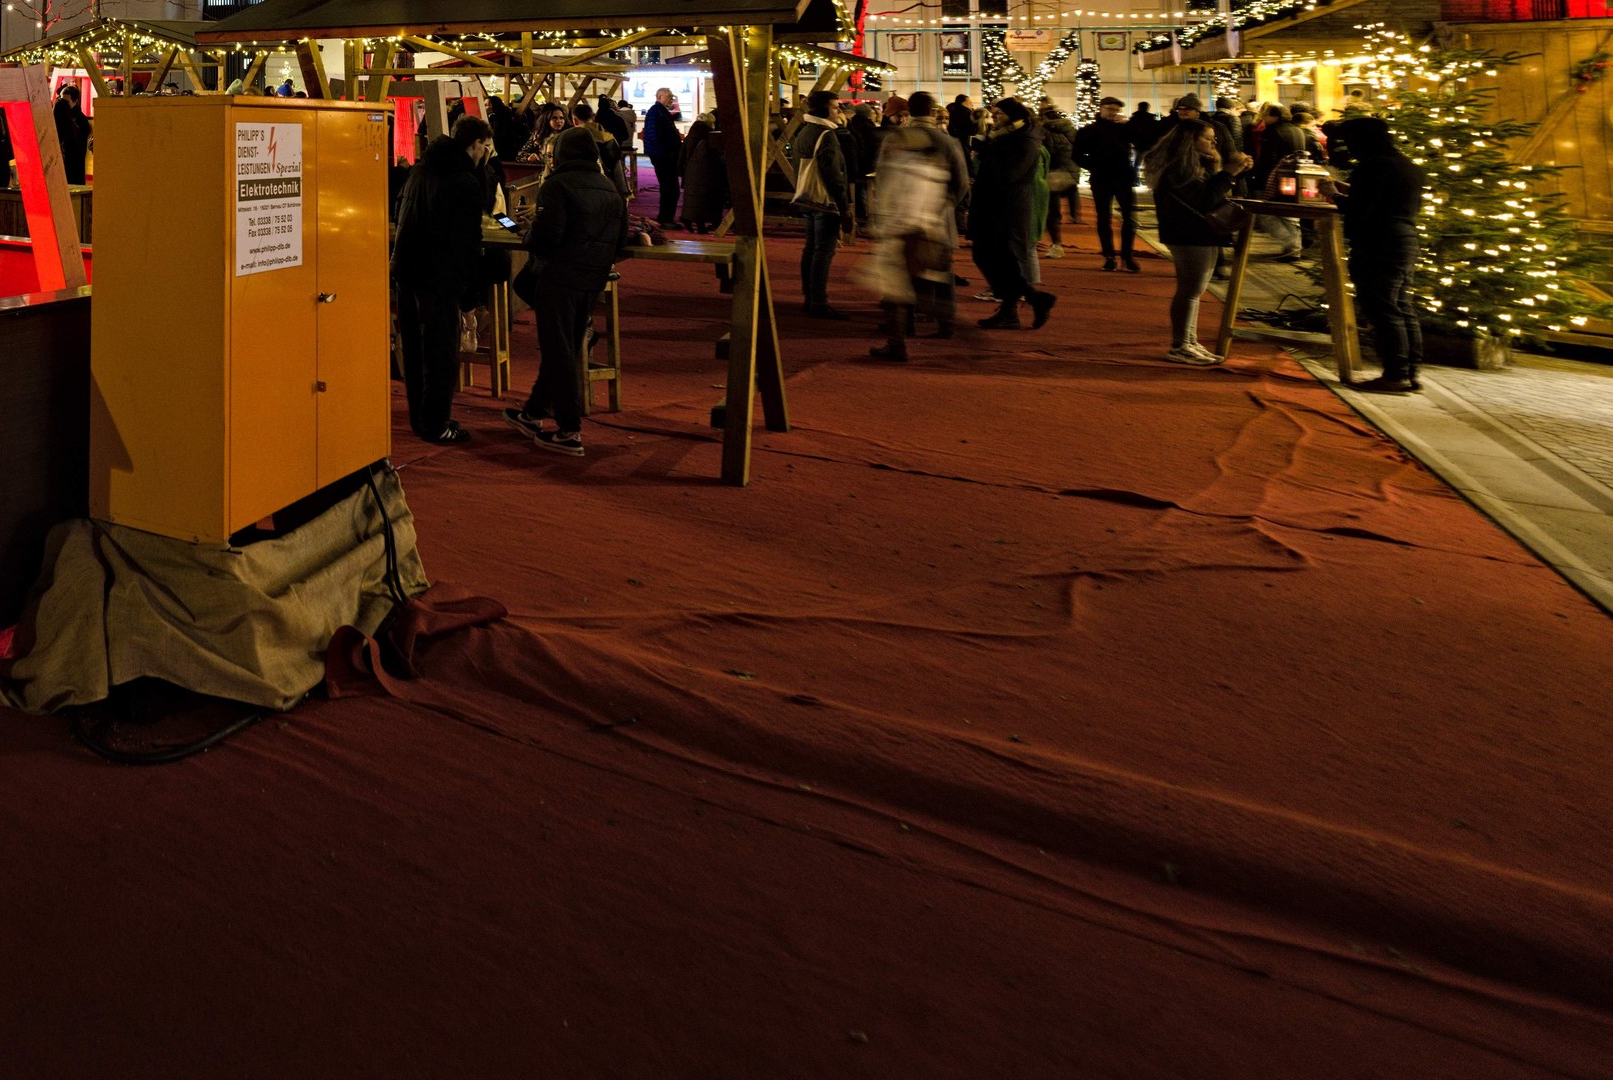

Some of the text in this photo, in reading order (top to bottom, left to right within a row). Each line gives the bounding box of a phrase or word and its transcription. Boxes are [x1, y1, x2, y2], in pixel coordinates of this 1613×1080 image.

[238, 146, 259, 158] DIENST-
[238, 161, 301, 177] LEISTUNGEN Spezial
[240, 181, 299, 197] Elektrotechnik
[248, 229, 256, 238] Fax
